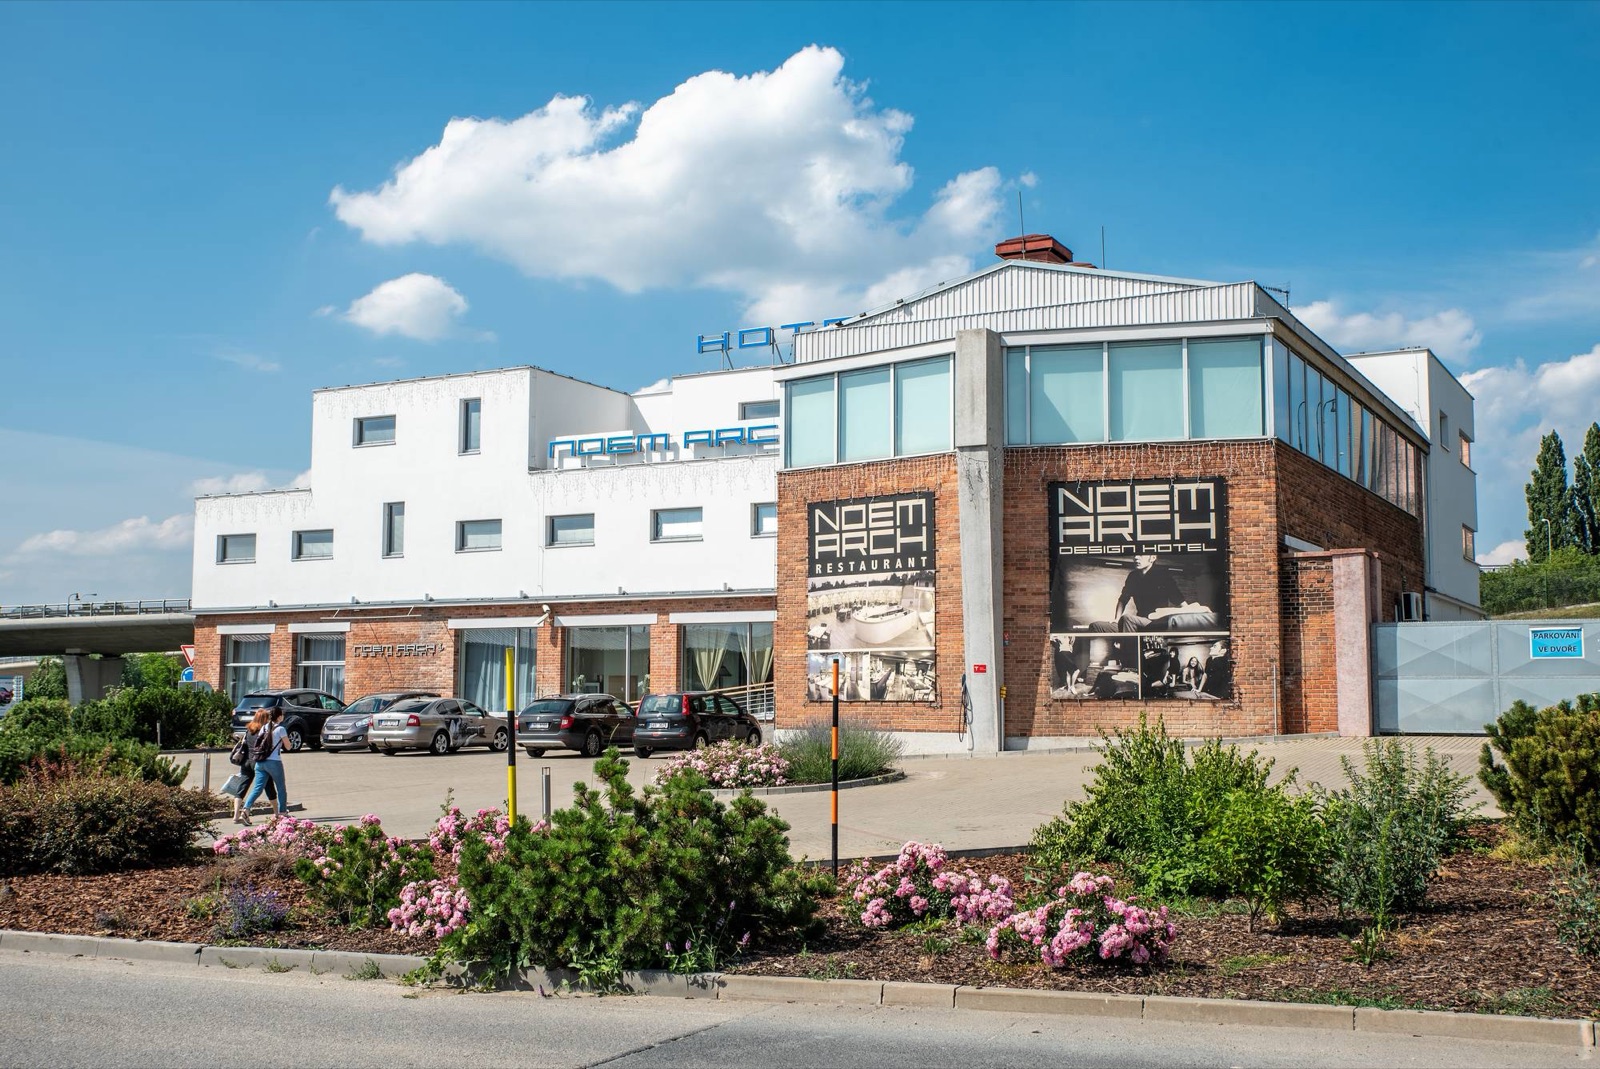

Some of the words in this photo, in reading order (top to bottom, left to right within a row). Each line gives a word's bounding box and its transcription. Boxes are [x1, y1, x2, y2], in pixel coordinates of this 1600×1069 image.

[549, 433, 668, 458] NOEM
[1058, 483, 1215, 514] NOEM
[815, 499, 926, 533] NOEM
[1058, 512, 1216, 543] ARCH
[815, 526, 927, 559] ARCH
[1059, 545, 1136, 555] DESIGN
[1142, 543, 1217, 553] HOTEL
[815, 557, 927, 574] RESTAURANT
[1533, 631, 1580, 639] PARKOVÁNÍ
[1550, 644, 1577, 653] DVOŘE
